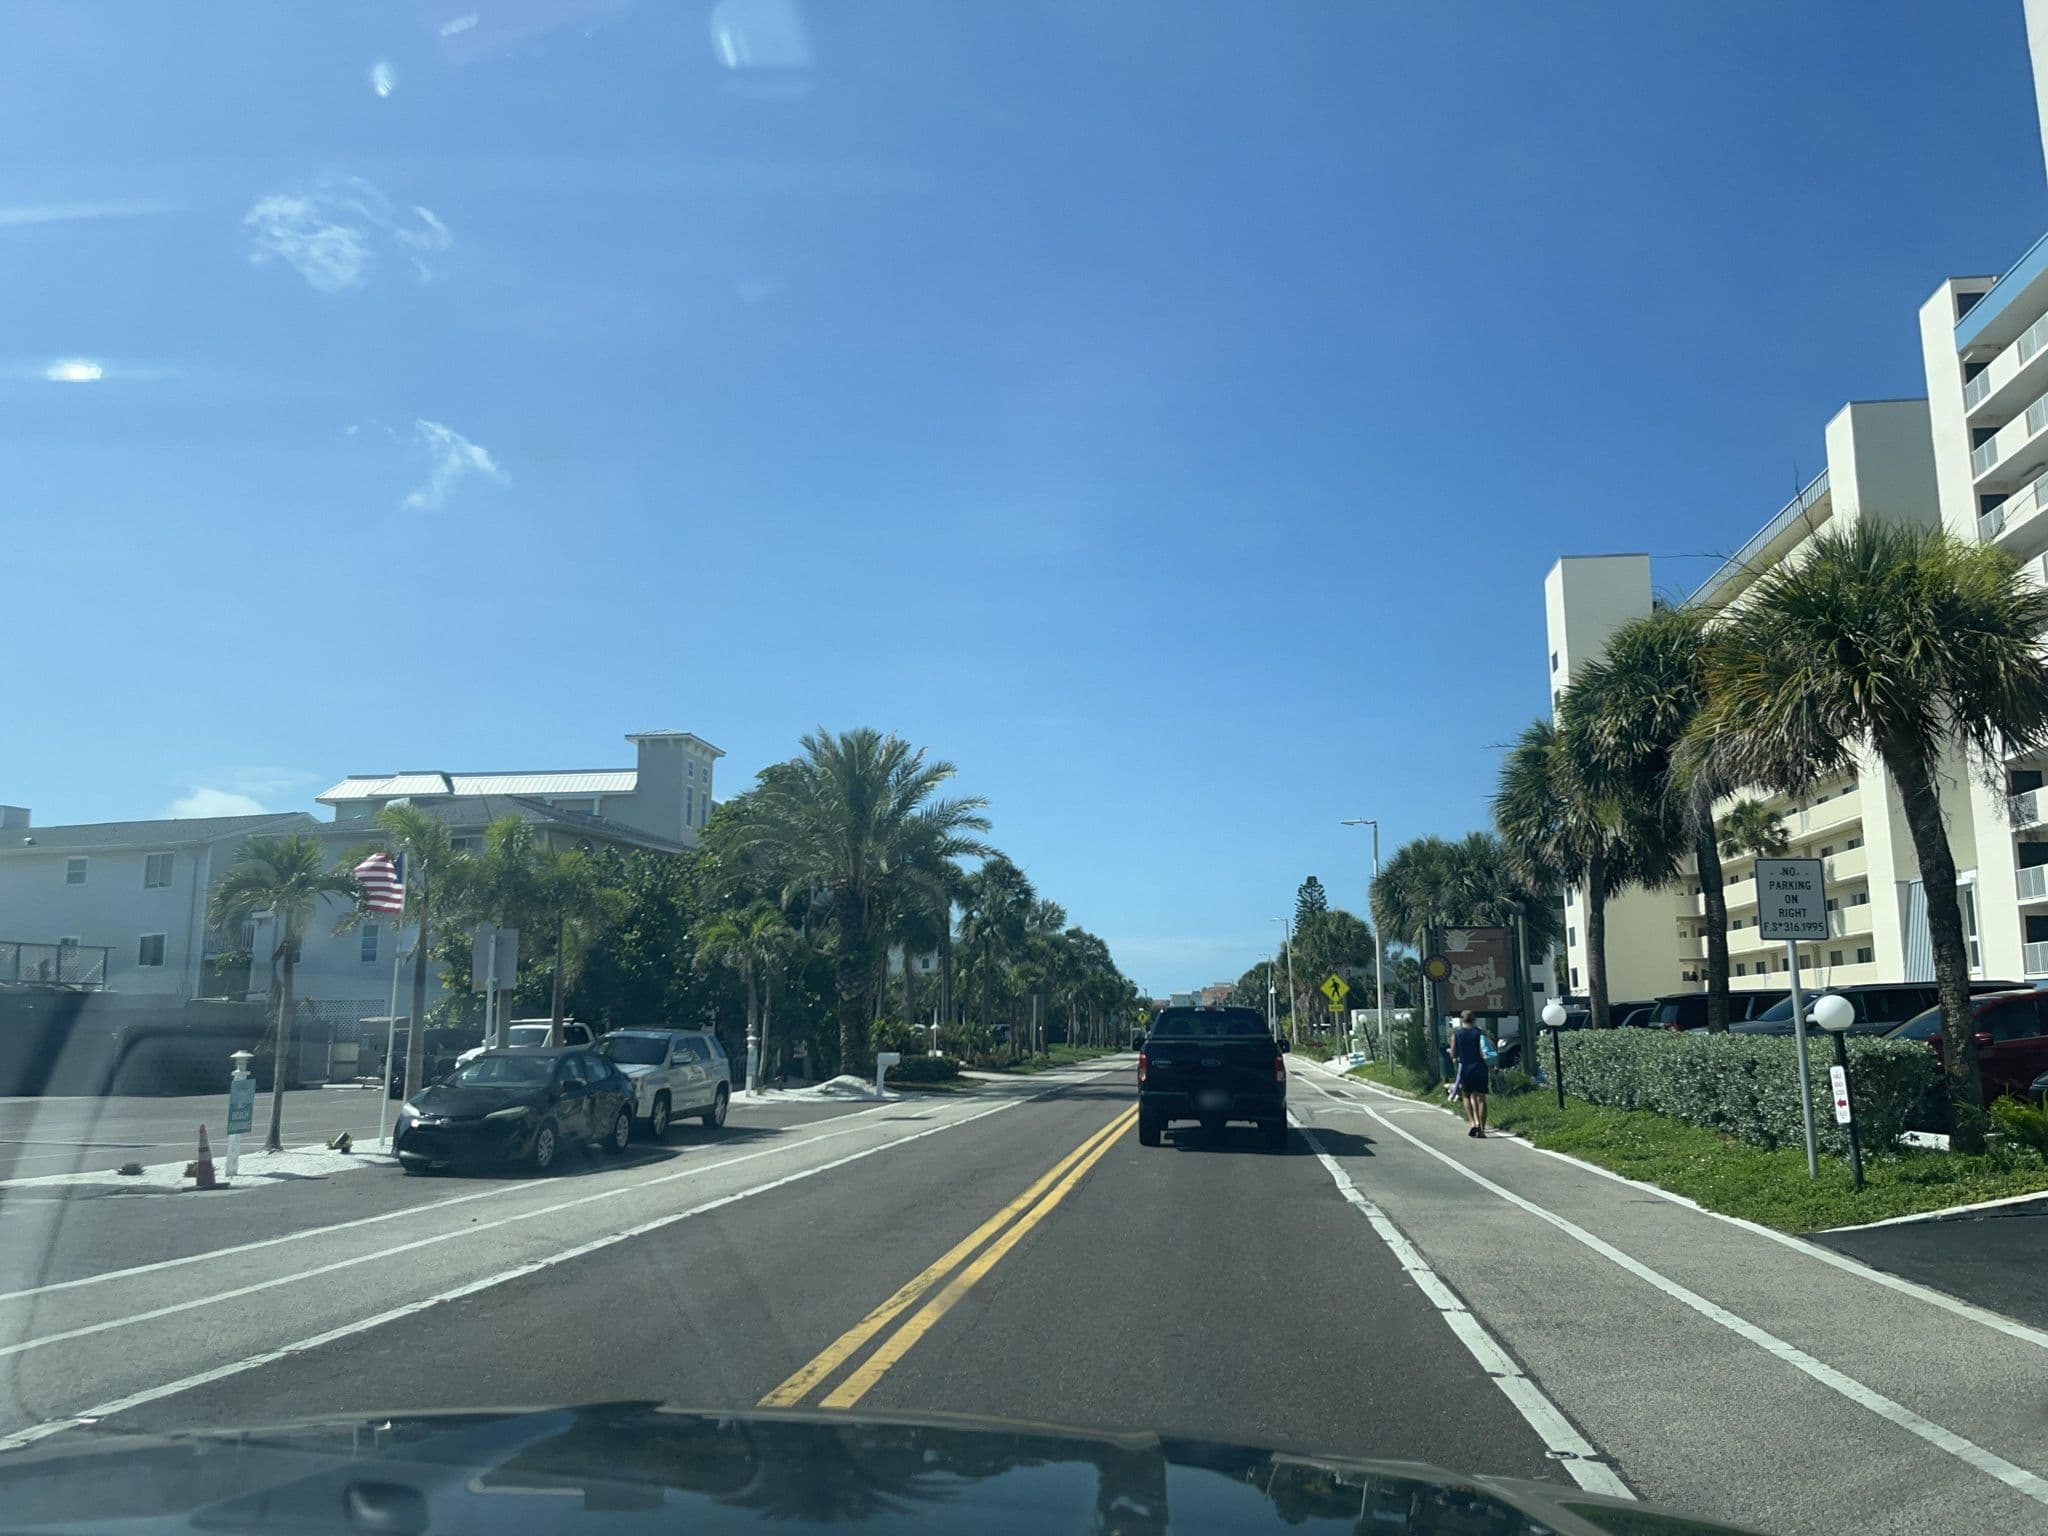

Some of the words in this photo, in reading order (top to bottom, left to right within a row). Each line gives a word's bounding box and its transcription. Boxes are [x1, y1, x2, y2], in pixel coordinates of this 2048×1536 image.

[1782, 867, 1796, 877] NO
[1769, 880, 1812, 891] PARKING
[1784, 894, 1798, 904] ON
[1778, 908, 1807, 918] RIGHT
